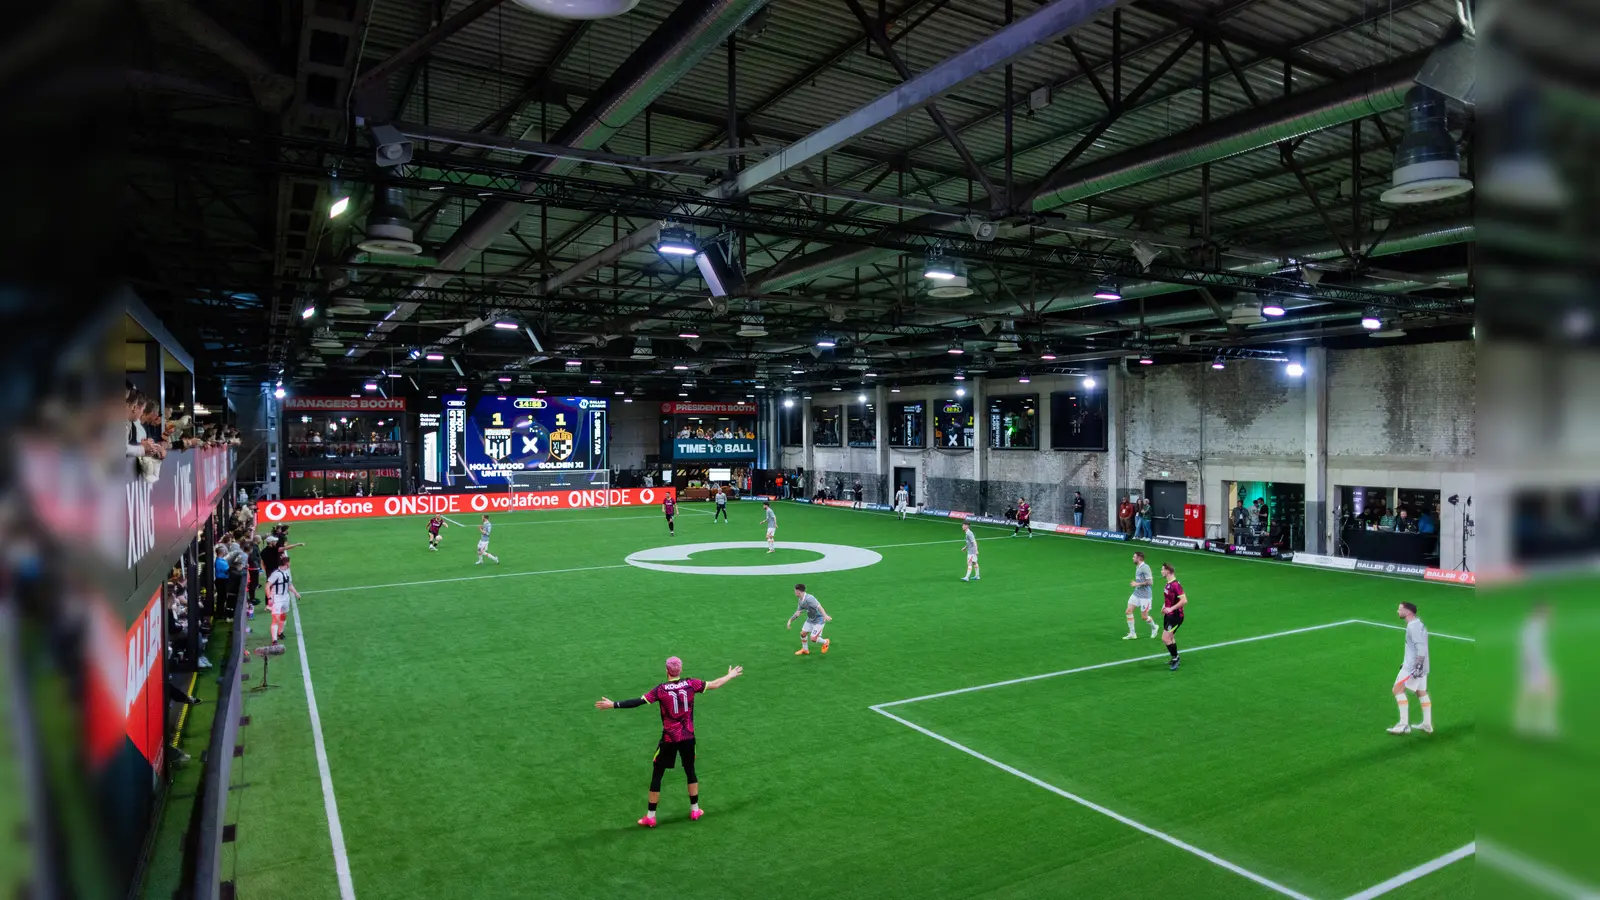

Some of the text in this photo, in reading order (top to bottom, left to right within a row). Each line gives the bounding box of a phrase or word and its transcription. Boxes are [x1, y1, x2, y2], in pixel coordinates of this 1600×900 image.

[285, 399, 403, 408] MANAGERS BOOTH
[675, 403, 755, 412] PRESIDENTS BOOTH
[492, 412, 504, 426] 1
[555, 413, 567, 426] 1
[449, 410, 457, 467] MOTORWORLD
[678, 443, 706, 453] TIME
[725, 443, 754, 453] BALL
[469, 463, 525, 471] HOLLYWOOD
[538, 461, 574, 469] GOLDEN
[290, 489, 631, 517] vodafone ONSIDE vodafone ONSIDE
[126, 480, 155, 570] XING
[1357, 562, 1425, 575] BALLER LEAGUE
[1427, 570, 1456, 579] BALLER
[667, 689, 689, 714] 11
